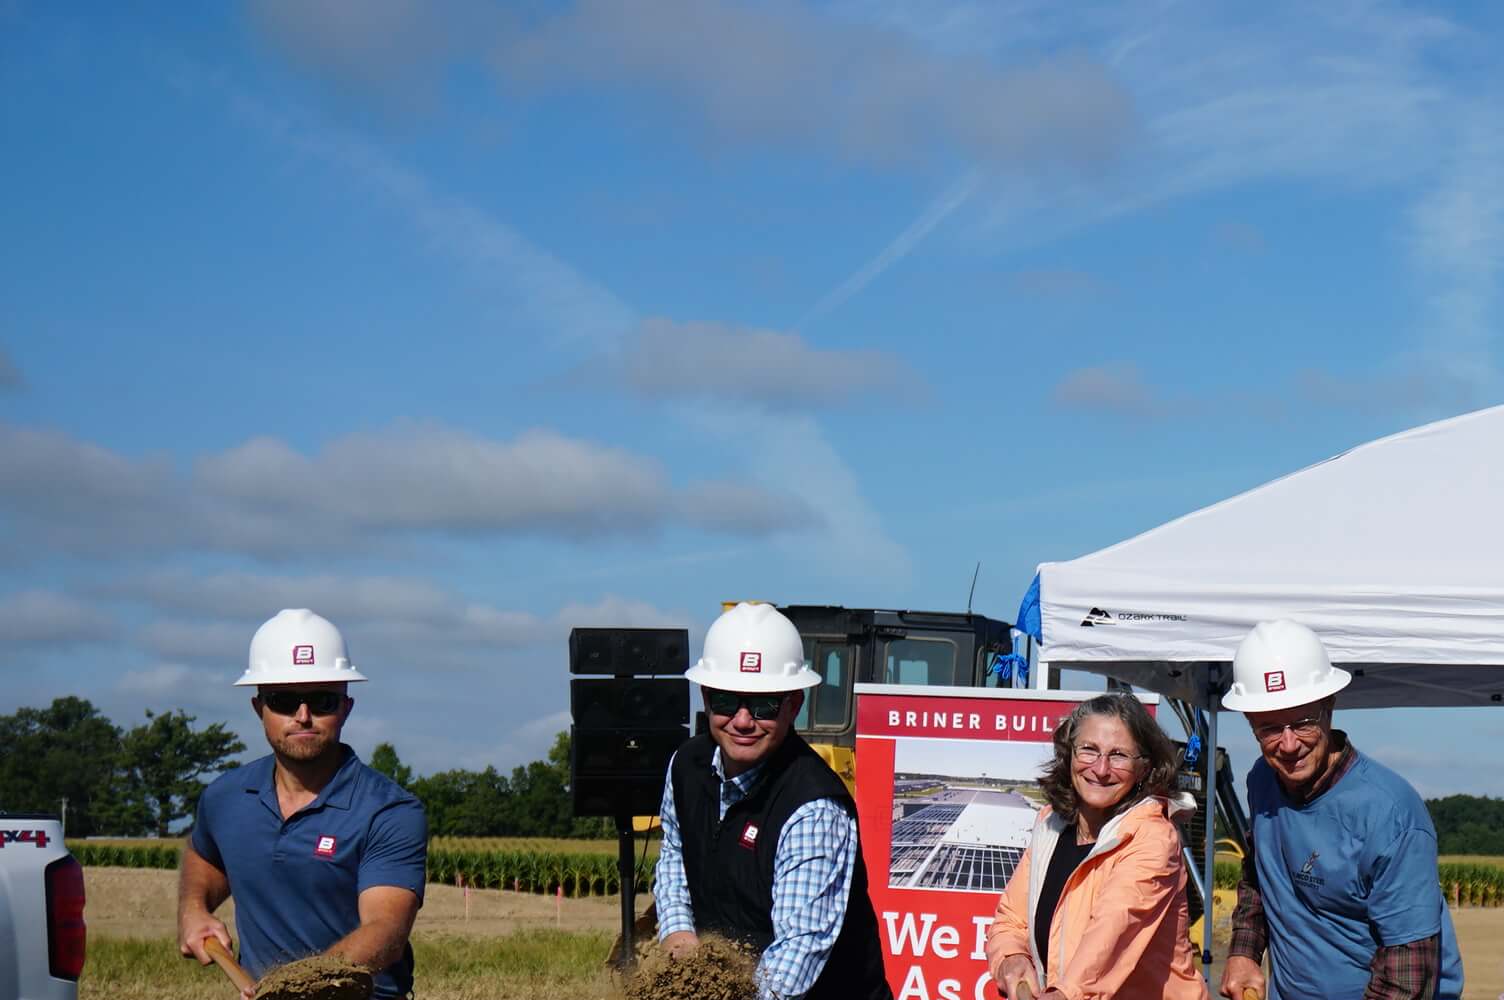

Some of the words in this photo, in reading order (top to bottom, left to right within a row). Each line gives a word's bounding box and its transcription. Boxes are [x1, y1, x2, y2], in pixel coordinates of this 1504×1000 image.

[888, 710, 981, 730] BRINER
[995, 714, 1068, 733] BUIL
[882, 911, 961, 959] We
